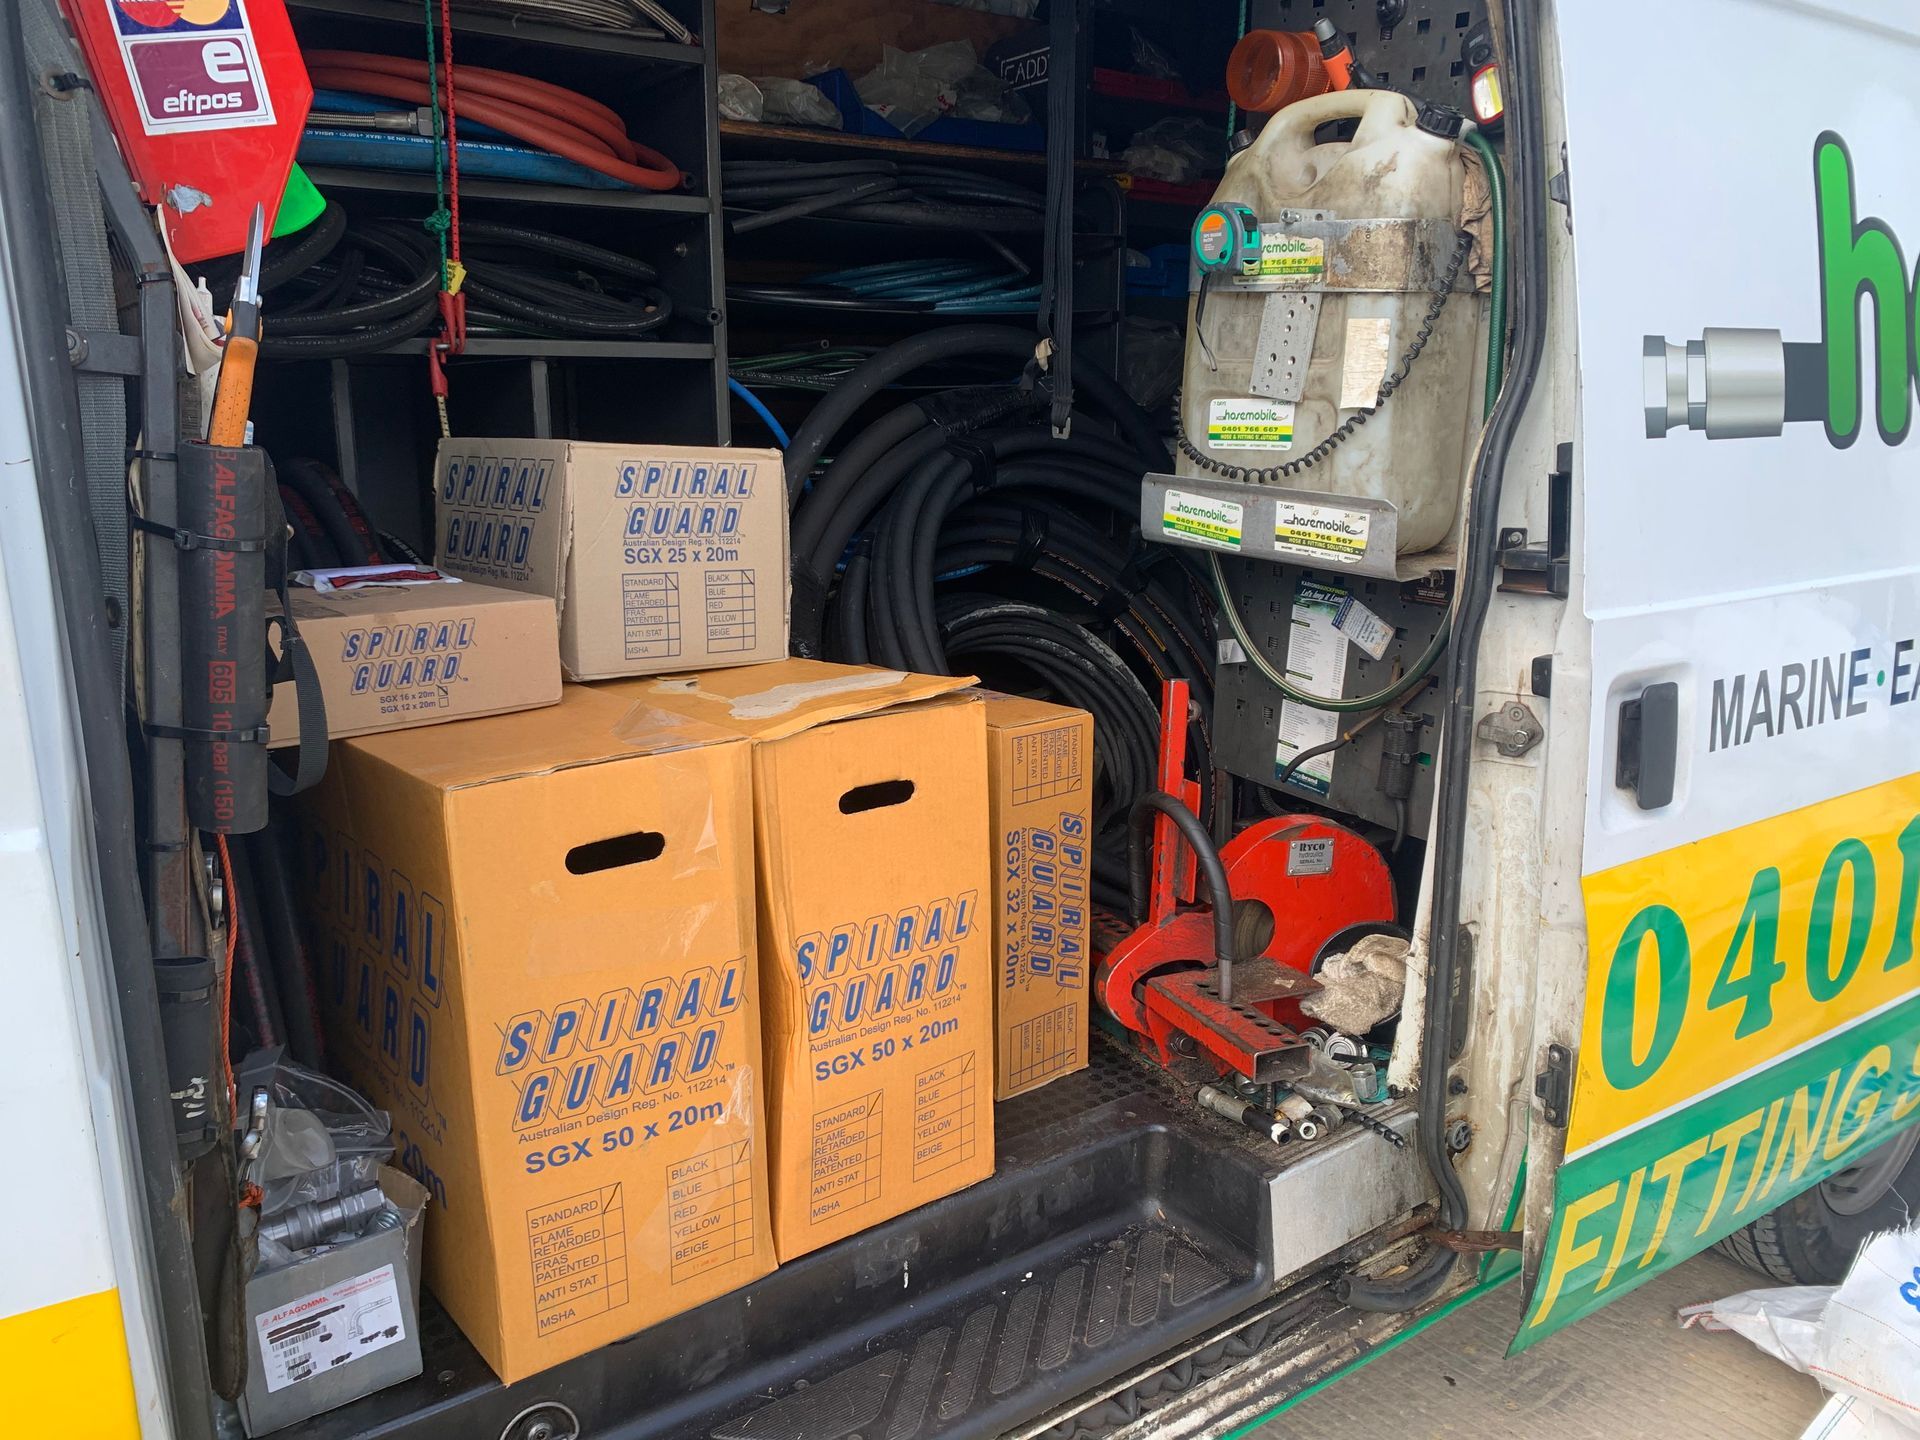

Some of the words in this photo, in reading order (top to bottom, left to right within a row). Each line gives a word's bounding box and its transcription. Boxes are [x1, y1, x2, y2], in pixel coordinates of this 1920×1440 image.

[1004, 52, 1050, 86] CADD
[163, 89, 243, 115] eftpos
[1224, 409, 1277, 421] hosemobile
[443, 458, 551, 511] SPIRAL
[617, 461, 753, 497] SPIRAL
[625, 504, 740, 537] GUARD
[1178, 501, 1227, 523] hosemobile
[1175, 516, 1195, 525] 0401
[1196, 522, 1212, 530] 766
[1214, 526, 1230, 534] 667
[1293, 513, 1351, 535] hosemobile
[446, 513, 533, 567] GUARD
[623, 539, 661, 547] Australian
[662, 539, 687, 547] Design
[688, 538, 704, 547] Reg.
[705, 538, 717, 546] No.
[718, 537, 741, 546] 112214
[1289, 529, 1312, 538] 0401
[1314, 534, 1332, 542] 766
[1335, 536, 1354, 545] 667
[624, 547, 663, 564] SGX
[667, 547, 687, 563] 25
[692, 550, 702, 562] x
[706, 546, 739, 562] 20m
[1326, 543, 1355, 554] SOLUTIONS
[624, 578, 664, 586] STANDARD
[707, 574, 730, 582] BLACK
[625, 592, 650, 600] FLAME
[708, 587, 726, 595] BLUE
[625, 599, 665, 607] RETARDED
[626, 608, 646, 617] FRAS
[708, 601, 724, 609] RED
[626, 616, 664, 624] PATENTED
[709, 613, 737, 622] YELLOW
[218, 625, 228, 655] ITALY
[344, 620, 473, 660] SPIRAL
[627, 630, 645, 638] ANTI
[646, 628, 663, 637] STAT
[709, 628, 730, 637] BEIGE
[627, 646, 649, 655] MSHA
[210, 662, 234, 703] 605
[353, 654, 460, 693] GUARD
[380, 694, 398, 704] SGX
[399, 693, 410, 702] 16
[418, 690, 436, 699] 20m
[380, 704, 400, 714] SGX
[401, 703, 411, 711] 12
[419, 701, 437, 709] 20m
[1708, 647, 1872, 754] MARINE
[213, 779, 236, 821] (150
[1006, 830, 1020, 883] SGX
[1299, 843, 1326, 852] RYCO
[1006, 889, 1020, 916] 32
[1029, 830, 1056, 975] GUARD
[1057, 814, 1085, 986] SPIRAL
[795, 893, 974, 983] SPIRAL
[1006, 922, 1017, 936] x
[1602, 815, 1920, 1091] 0401
[1005, 941, 1020, 989] 20m
[809, 949, 957, 1038] GUARD
[500, 960, 742, 1072] SPIRAL
[809, 1032, 858, 1053] Australian
[859, 1020, 891, 1037] Design
[893, 1012, 915, 1026] Reg.
[916, 1007, 931, 1018] No.
[933, 994, 961, 1011] 112214
[815, 1047, 866, 1082] SGX
[871, 1038, 896, 1062] 50
[902, 1035, 914, 1051] x
[919, 1017, 959, 1045] 20m
[516, 1024, 721, 1128] GUARD
[918, 1069, 946, 1088] BLACK
[918, 1088, 941, 1106] BLUE
[518, 1119, 582, 1145] Australian
[585, 1107, 629, 1127] Design
[632, 1098, 660, 1115] Reg.
[662, 1090, 683, 1102] No.
[686, 1074, 727, 1094] 112214
[814, 1104, 866, 1131] STANDARD
[917, 1109, 936, 1124] RED
[524, 1138, 594, 1174] SGX
[601, 1126, 635, 1152] 50
[644, 1121, 661, 1140] x
[667, 1101, 724, 1132] 20m
[814, 1127, 847, 1146] FLAME
[917, 1118, 952, 1140] YELLOW
[814, 1130, 865, 1157] RETARDED
[916, 1141, 943, 1161] BEIGE
[671, 1159, 709, 1180] BLACK
[813, 1152, 862, 1179] PATENTED
[814, 1152, 840, 1169] FRAS
[672, 1182, 703, 1201] BLUE
[812, 1180, 836, 1197] ANTI
[837, 1170, 860, 1186] STAT
[1530, 1044, 1892, 1328] FITTING
[530, 1199, 599, 1229] STANDARD
[673, 1204, 698, 1220] RED
[812, 1200, 841, 1218] MSHA
[532, 1225, 575, 1248] FLAME
[674, 1214, 721, 1239] YELLOW
[533, 1228, 601, 1259] RETARDED
[675, 1240, 709, 1261] BEIGE
[535, 1253, 569, 1273] FRAS
[536, 1253, 600, 1285] PATENTED
[537, 1285, 567, 1305] ANTI
[569, 1274, 598, 1293] STAT
[271, 1295, 329, 1323] ALFAGOMMA
[539, 1308, 576, 1329] MSHA
